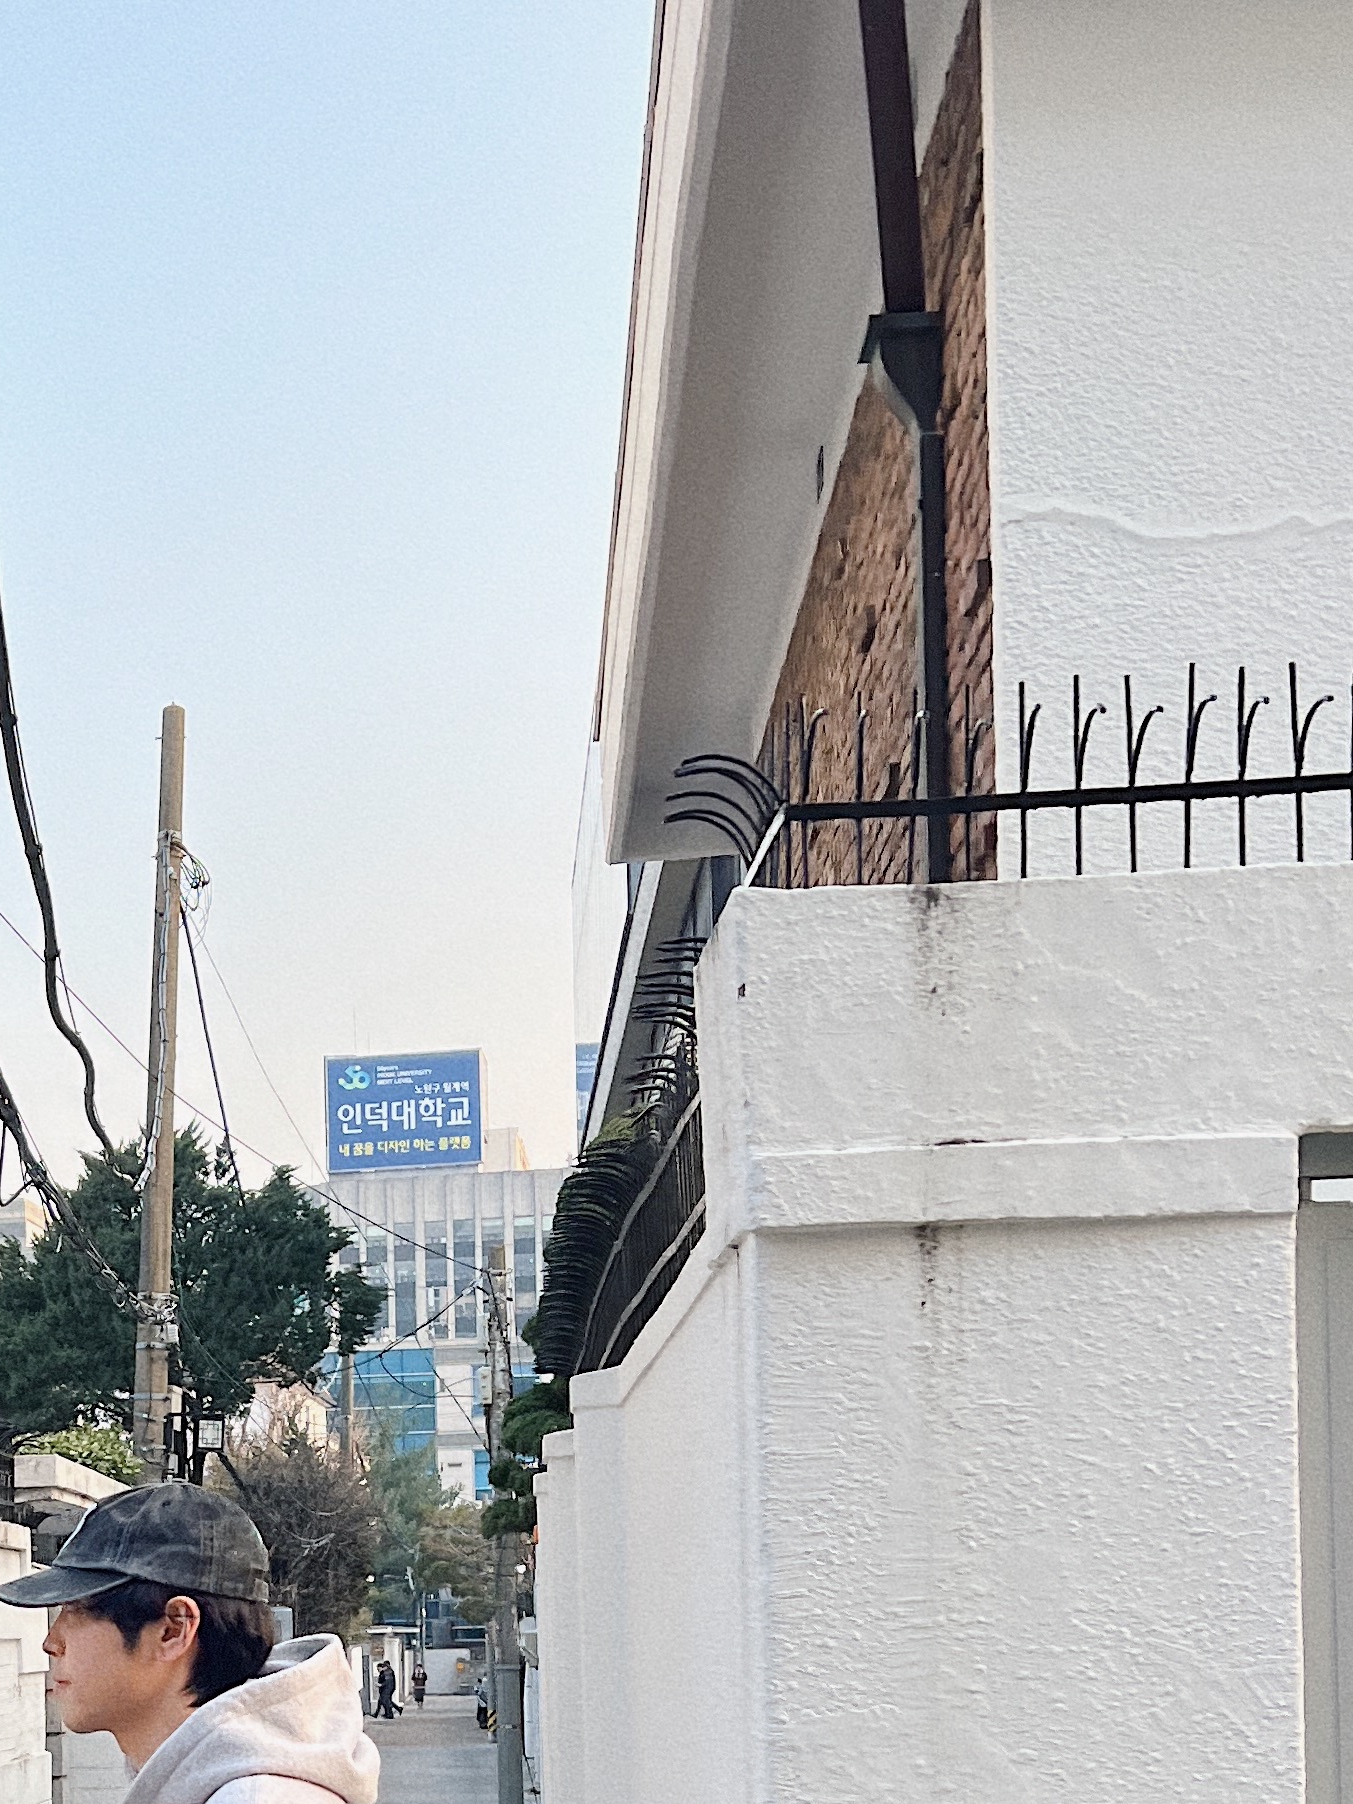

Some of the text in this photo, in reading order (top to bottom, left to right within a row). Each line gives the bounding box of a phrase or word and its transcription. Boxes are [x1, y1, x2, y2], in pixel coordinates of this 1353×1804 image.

[337, 1097, 472, 1135] 인덕대학교
[338, 1135, 471, 1157] 내 꿈을 디자인 하는 플랫폼
